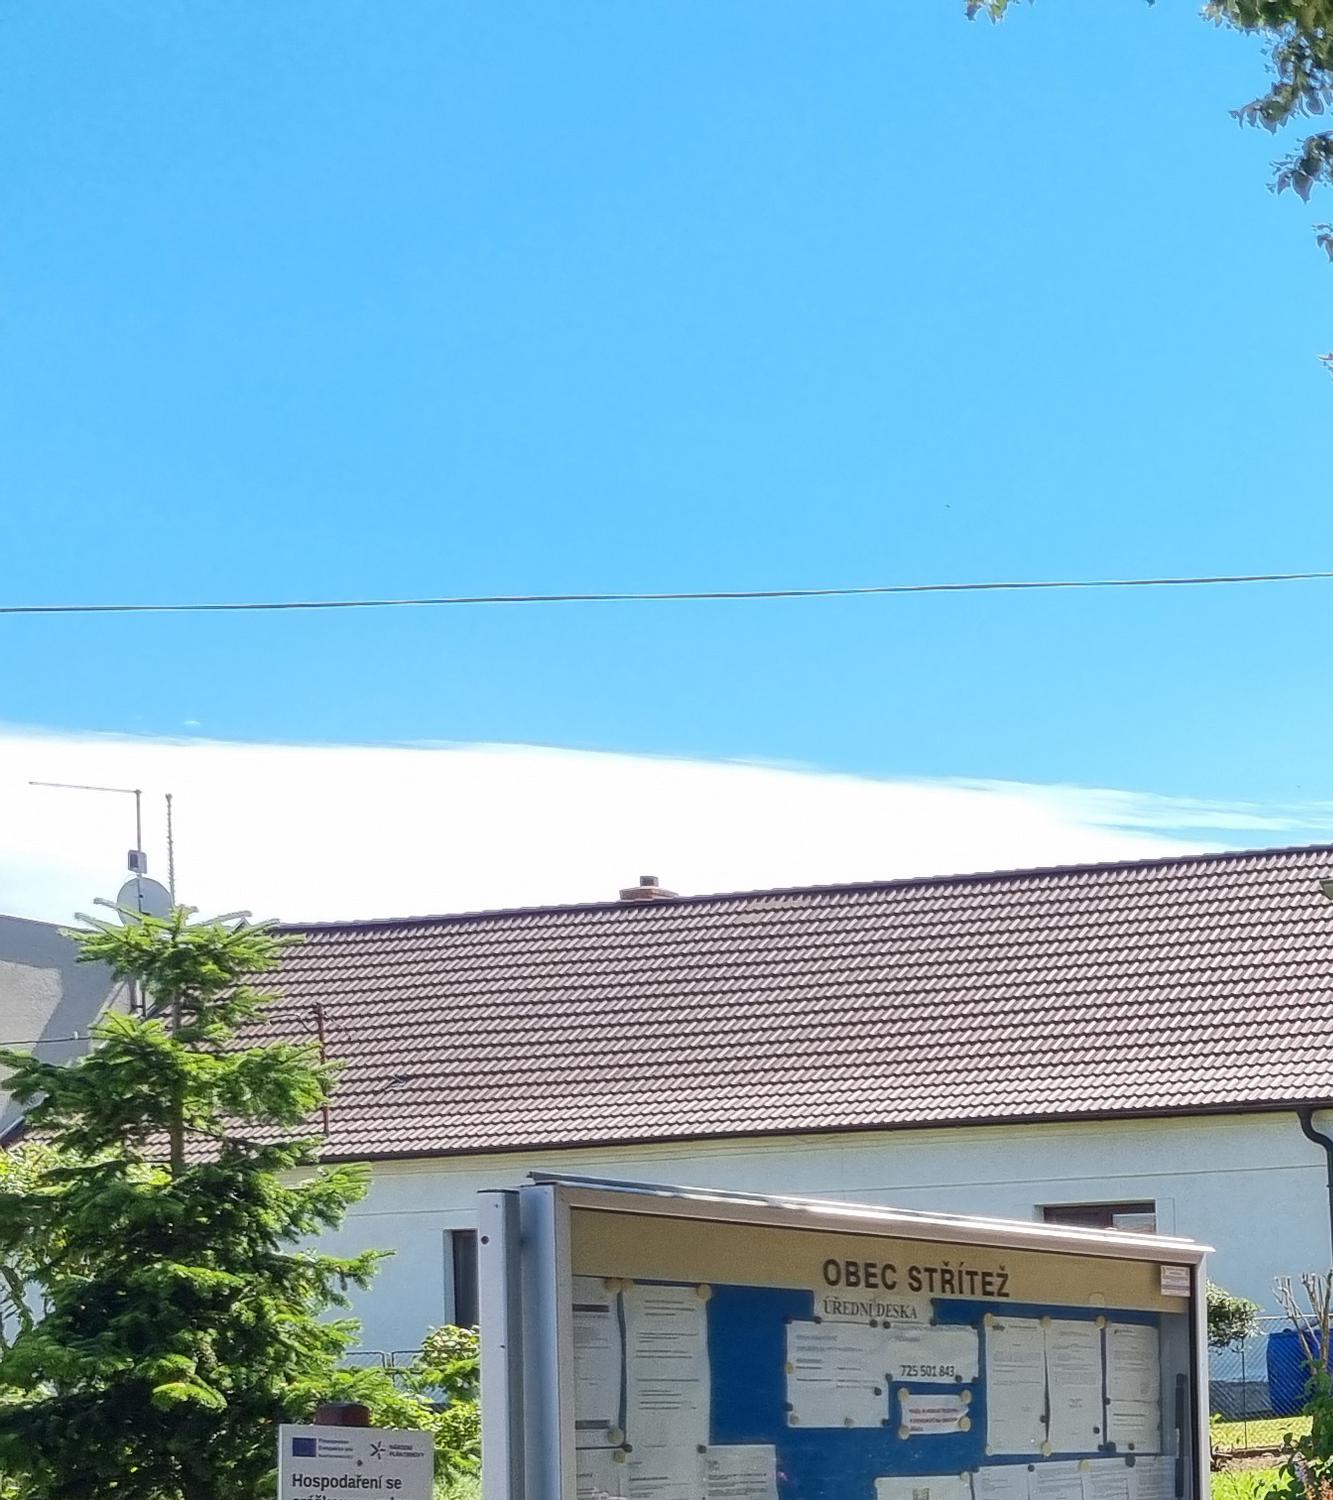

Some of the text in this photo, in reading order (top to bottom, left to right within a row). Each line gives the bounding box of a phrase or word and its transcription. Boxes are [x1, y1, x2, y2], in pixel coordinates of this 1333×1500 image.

[822, 1258, 1010, 1298] OBEC STŘÍTEŽ
[822, 1296, 918, 1319] ÚŘEDNÍ DESKA
[900, 1364, 919, 1377] 725
[920, 1365, 937, 1377] 501
[292, 1473, 402, 1491] Hospodaření se
